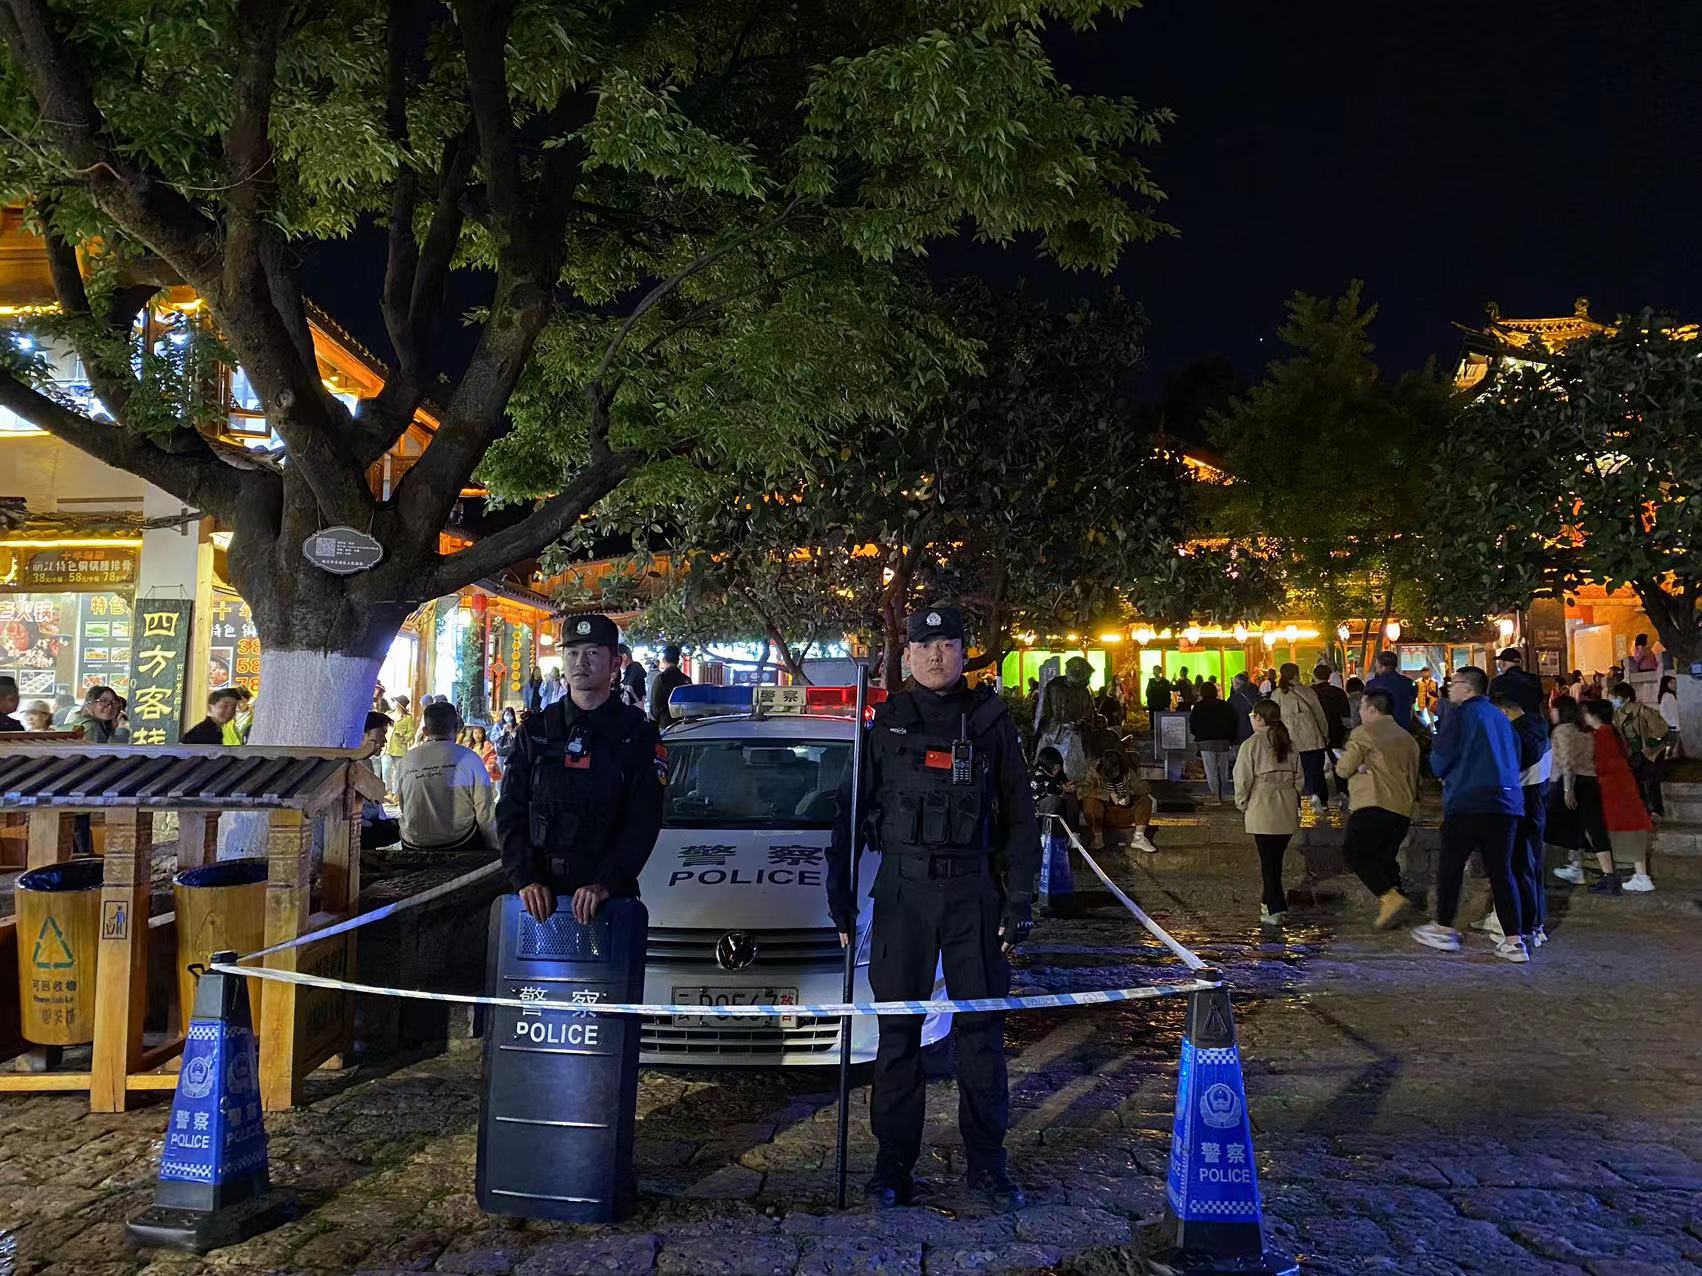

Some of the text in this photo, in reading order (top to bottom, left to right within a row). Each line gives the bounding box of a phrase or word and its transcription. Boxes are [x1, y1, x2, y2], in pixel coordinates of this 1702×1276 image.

[761, 690, 798, 702] 警察
[677, 845, 823, 867] 警察
[669, 869, 821, 886] POLICE
[519, 986, 600, 1018] 警察
[517, 1022, 599, 1045] POLICE
[176, 1110, 210, 1130] 警察
[171, 1134, 210, 1149] POLICE
[1201, 1142, 1246, 1163] 警察
[1199, 1168, 1250, 1183] POLICE
